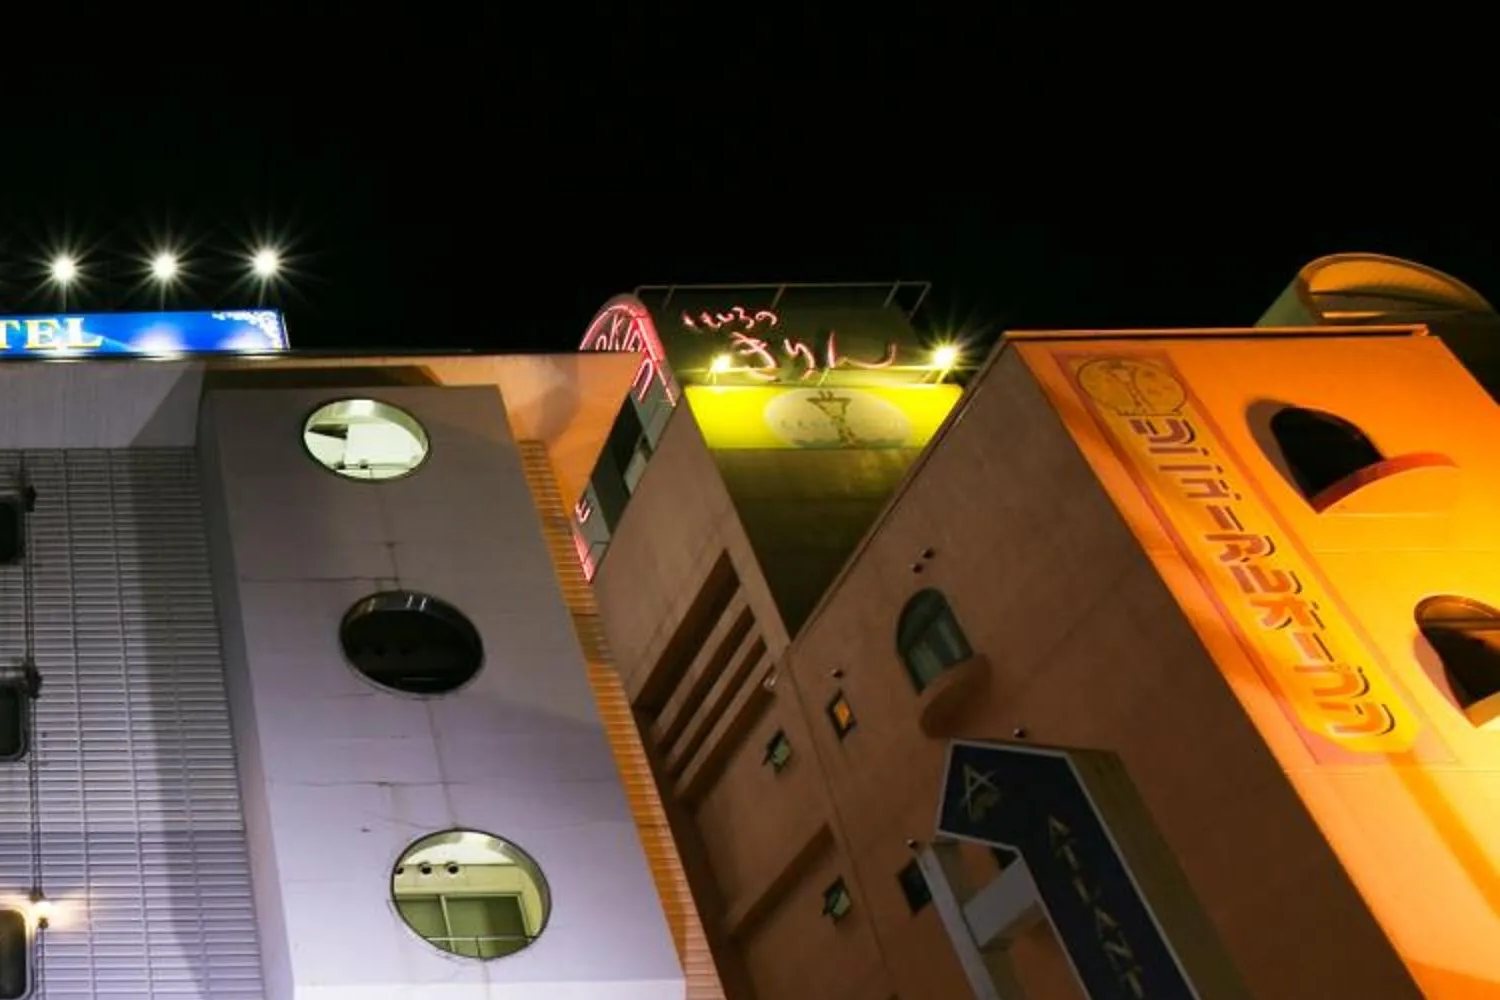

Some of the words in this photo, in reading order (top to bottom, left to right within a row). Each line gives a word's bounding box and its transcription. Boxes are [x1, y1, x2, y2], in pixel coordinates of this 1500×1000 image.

[1130, 416, 1396, 737] リニューアルオープン
